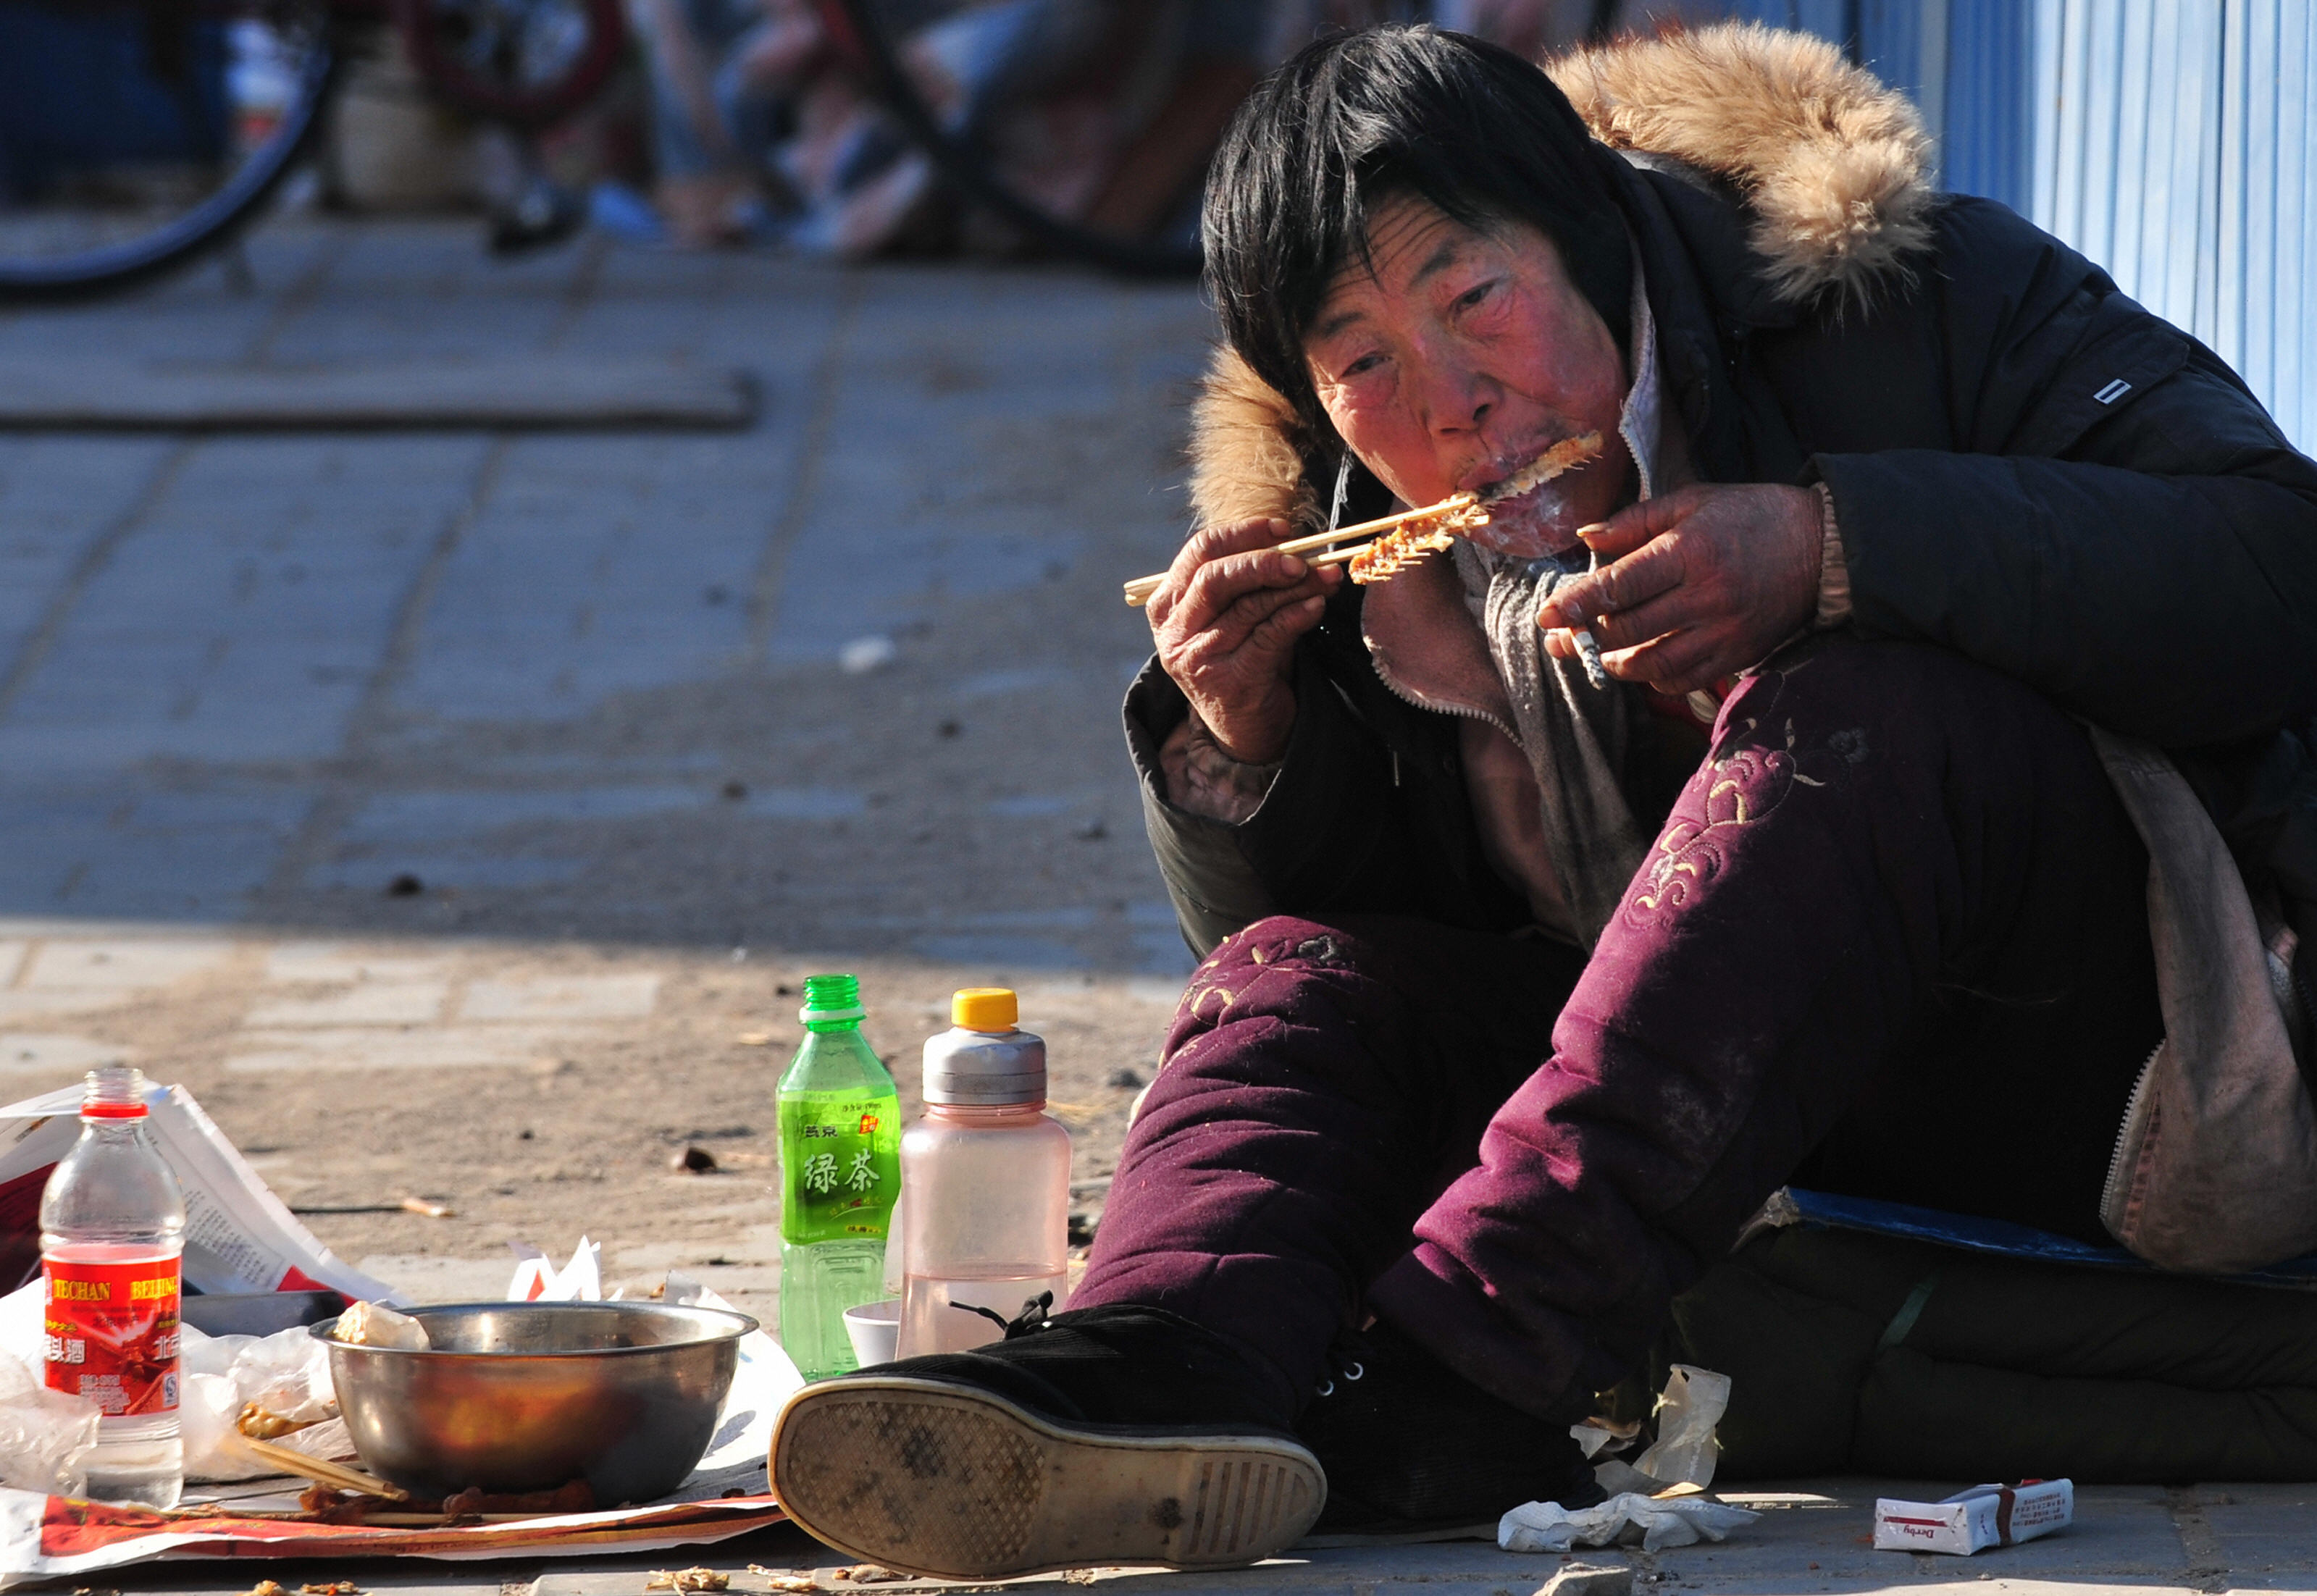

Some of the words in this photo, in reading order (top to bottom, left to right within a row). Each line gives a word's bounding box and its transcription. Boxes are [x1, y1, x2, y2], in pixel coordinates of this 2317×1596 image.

[805, 1125, 838, 1138] 燕京
[804, 1147, 881, 1194] 绿茶
[53, 1278, 111, 1301] TECHAN
[1903, 1524, 1935, 1539] Derby
